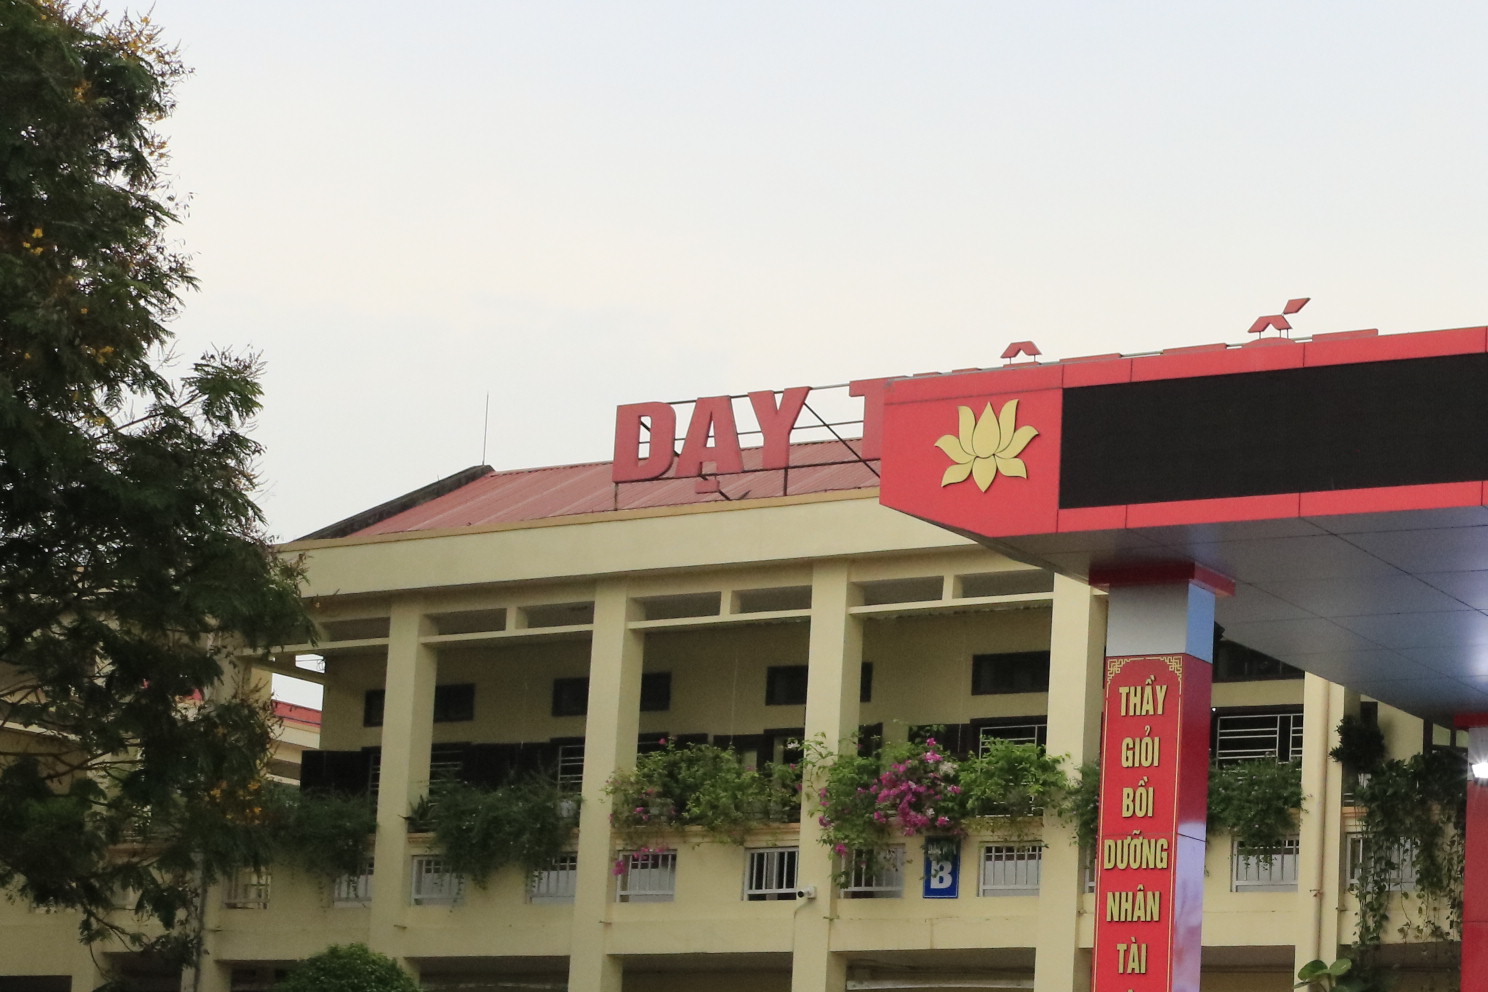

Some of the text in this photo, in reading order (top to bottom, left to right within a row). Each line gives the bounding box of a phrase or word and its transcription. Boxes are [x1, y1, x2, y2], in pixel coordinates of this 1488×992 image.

[612, 386, 812, 494] DẠY
[1118, 675, 1168, 717] THẦY
[1121, 725, 1161, 769] GIỎI
[1121, 776, 1155, 818] BỒI
[1103, 830, 1169, 870] DƯỠNG
[930, 860, 953, 889] B
[1106, 884, 1161, 922] NHÂN
[1116, 937, 1148, 974] TÀI
